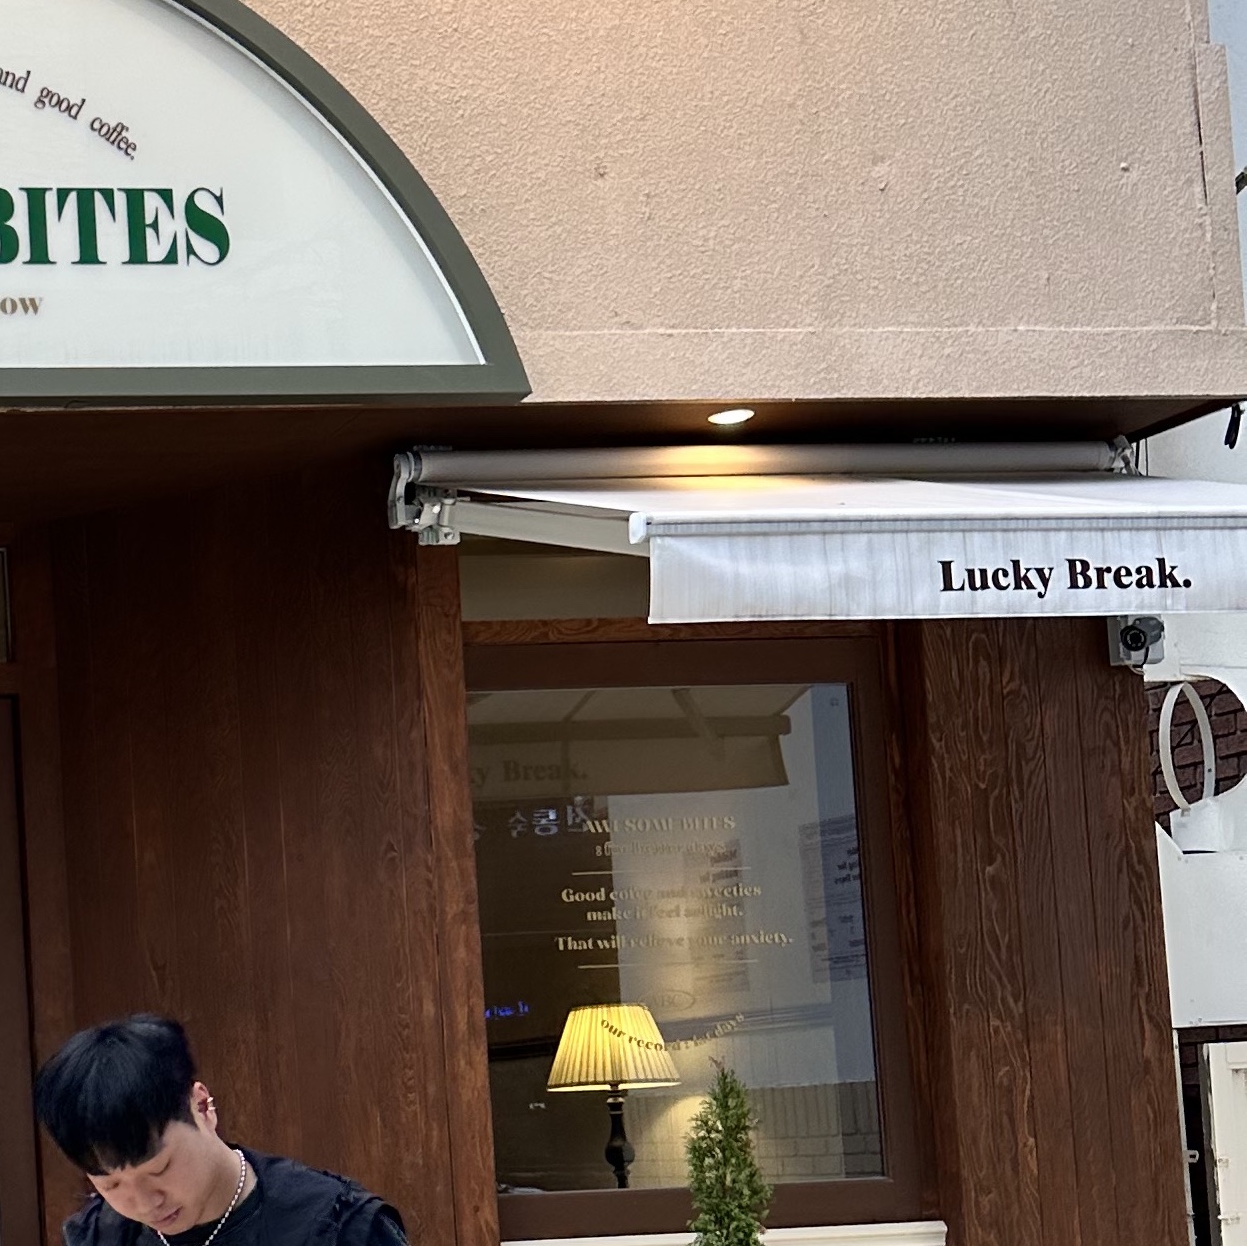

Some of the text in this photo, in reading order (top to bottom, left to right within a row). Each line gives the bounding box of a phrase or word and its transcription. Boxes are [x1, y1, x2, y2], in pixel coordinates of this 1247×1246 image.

[33, 84, 87, 121] good
[88, 112, 138, 161] coffee.
[937, 556, 1193, 599] Lucky Break.
[560, 887, 605, 903] Good
[585, 904, 634, 921] make
[555, 936, 594, 952] That
[596, 933, 623, 950] will
[728, 929, 795, 949] anxiety.
[600, 1018, 627, 1040] our
